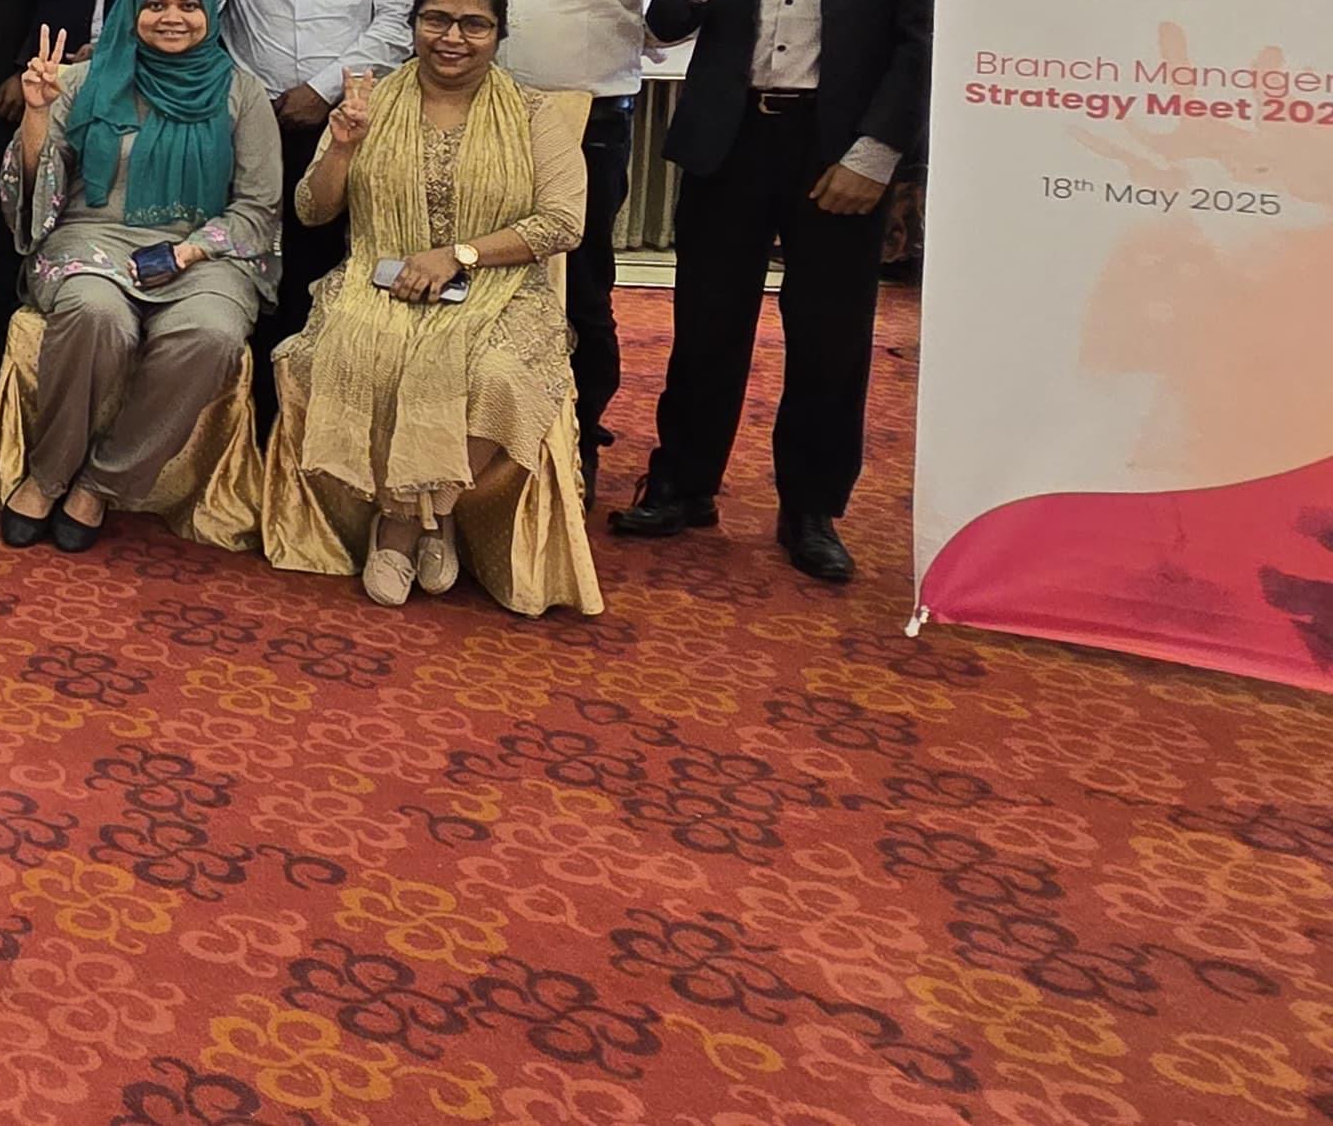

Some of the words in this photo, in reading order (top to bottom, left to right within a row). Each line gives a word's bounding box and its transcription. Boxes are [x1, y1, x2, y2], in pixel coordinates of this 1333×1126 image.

[976, 51, 1119, 82] Branch
[1135, 60, 1333, 99] Manager
[965, 82, 1137, 120] Strategy
[1146, 93, 1252, 122] Meet
[1261, 98, 1333, 126] 202
[1042, 176, 1094, 200] 18th
[1105, 183, 1180, 212] May
[1190, 188, 1281, 216] 2025
